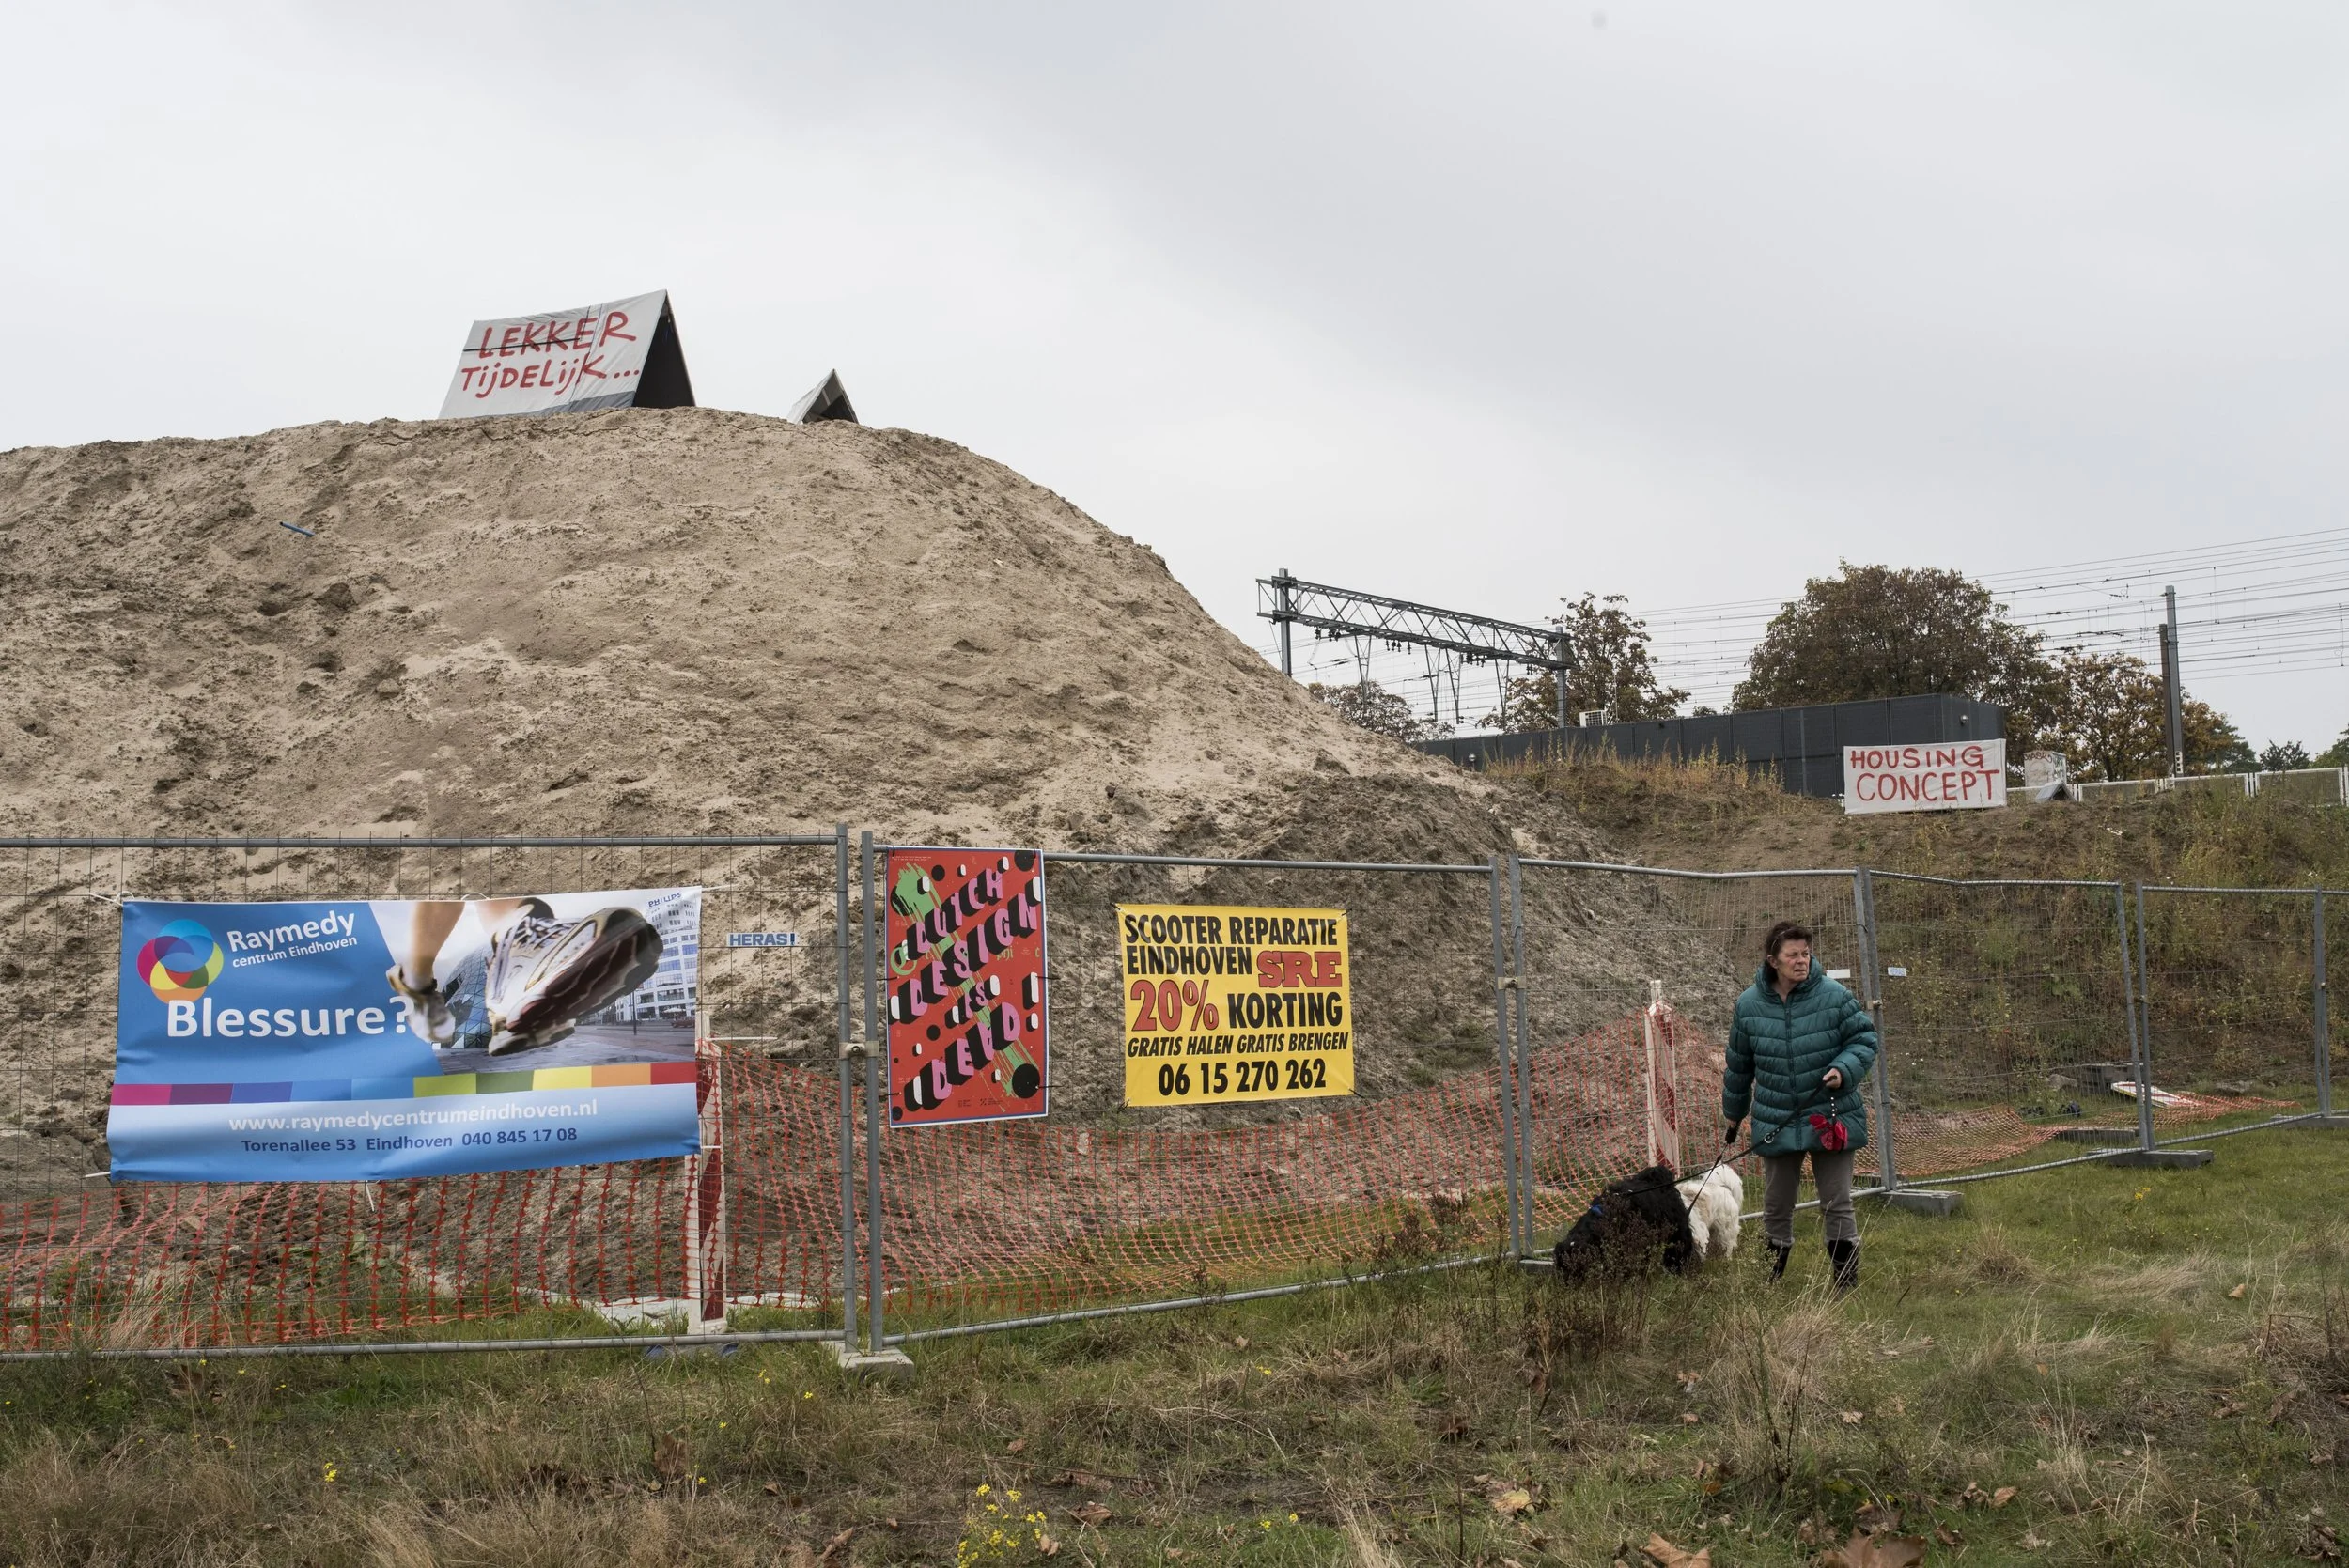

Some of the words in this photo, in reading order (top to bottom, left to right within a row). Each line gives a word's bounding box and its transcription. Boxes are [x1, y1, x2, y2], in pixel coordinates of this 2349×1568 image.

[477, 311, 637, 359] LEKKER
[1850, 746, 1985, 769] HOUSING
[1856, 769, 2000, 801] CONCEPT
[648, 892, 682, 908] PHILIPS
[226, 909, 356, 953] Raymedy
[1124, 914, 1223, 945] SCOOTER
[1228, 916, 1338, 946] REPARATIE
[232, 949, 287, 969] centrum
[289, 935, 358, 958] Eindhoven
[908, 893, 1038, 1018] DESIGN
[1127, 945, 1252, 976] EINDHOVEN
[1256, 950, 1343, 988] SRE
[167, 996, 415, 1038] Blessure?
[1130, 979, 1220, 1032] 20%
[1227, 992, 1343, 1029] KORTING
[1128, 1036, 1183, 1058] GRATIS
[1186, 1034, 1234, 1055] HALEN
[1237, 1033, 1285, 1054] GRATIS
[1288, 1032, 1349, 1052] BRENGEN
[1158, 1063, 1190, 1096] 06
[1201, 1062, 1229, 1094] 15
[1236, 1059, 1279, 1093] 270
[1285, 1058, 1327, 1091] 262
[228, 1099, 598, 1132] www.raymedycentrumeindhoven.nl
[241, 1138, 331, 1152] Torenallee
[336, 1138, 356, 1151] 53
[366, 1134, 453, 1151] Eindhoven
[461, 1131, 492, 1146] 040
[497, 1130, 527, 1144] 845
[533, 1128, 552, 1143] 17
[557, 1127, 578, 1141] 08
